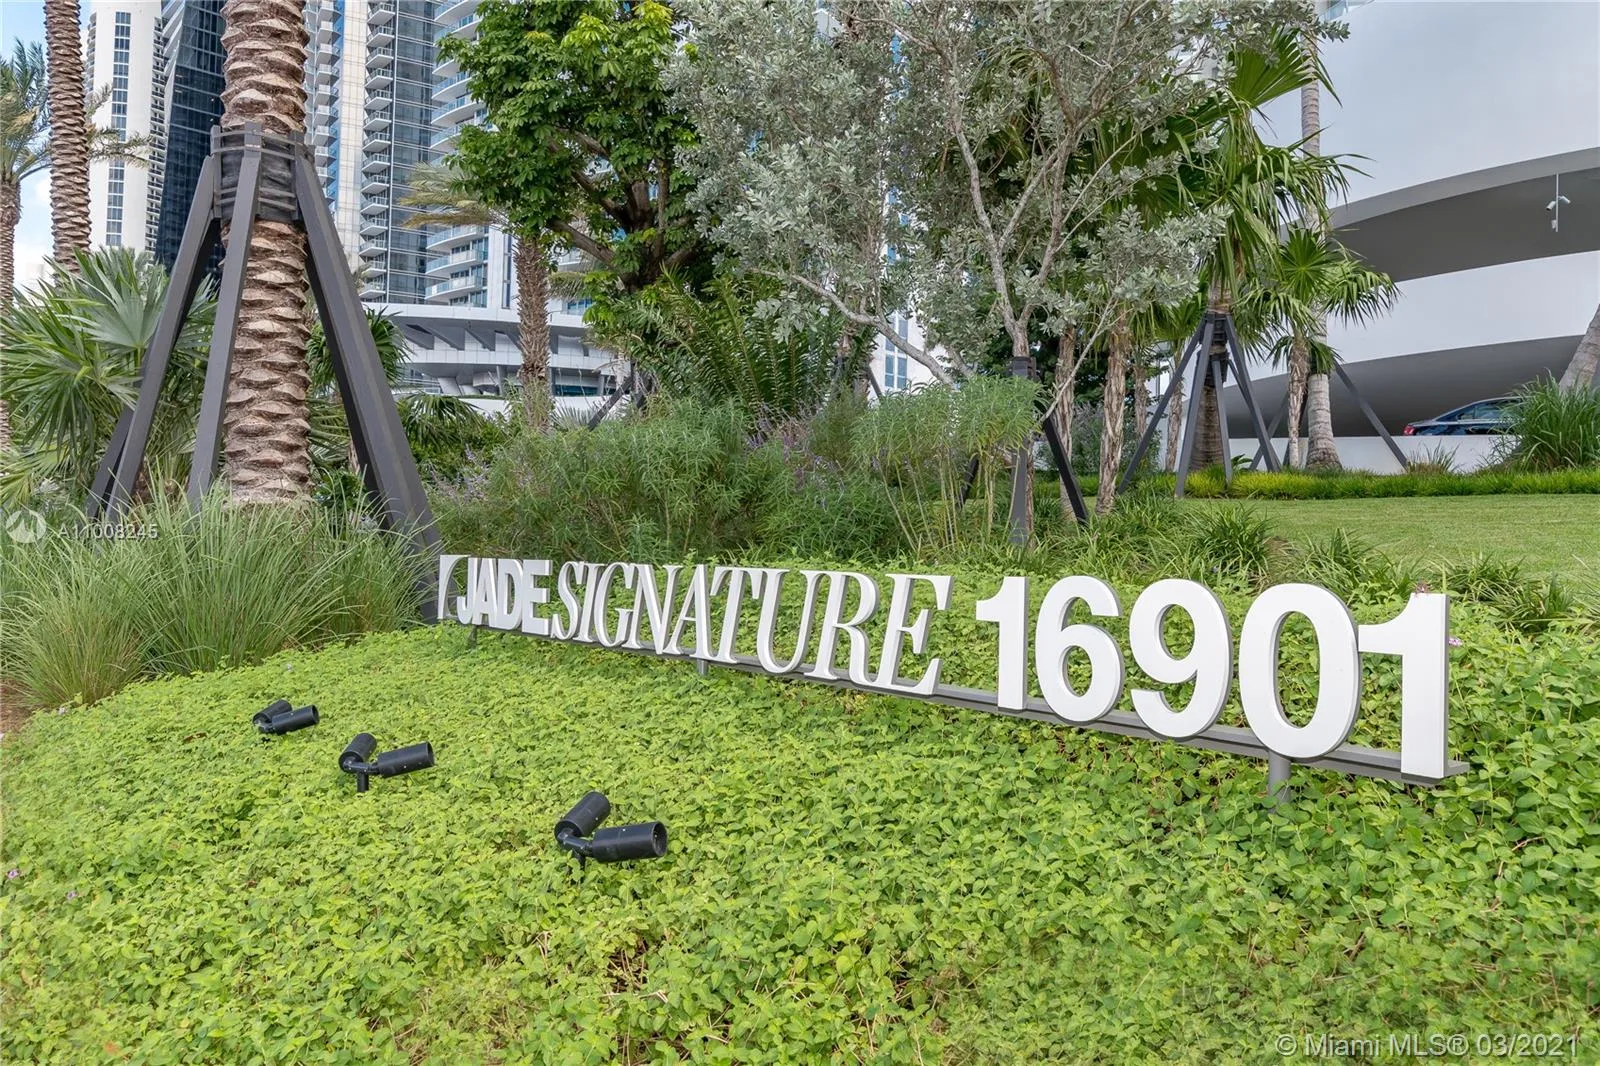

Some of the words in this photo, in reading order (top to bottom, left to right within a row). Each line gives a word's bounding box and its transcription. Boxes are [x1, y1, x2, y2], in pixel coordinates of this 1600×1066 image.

[456, 558, 552, 636] JADE
[551, 561, 953, 696] SIGNATURE
[976, 575, 1450, 779] 16901
